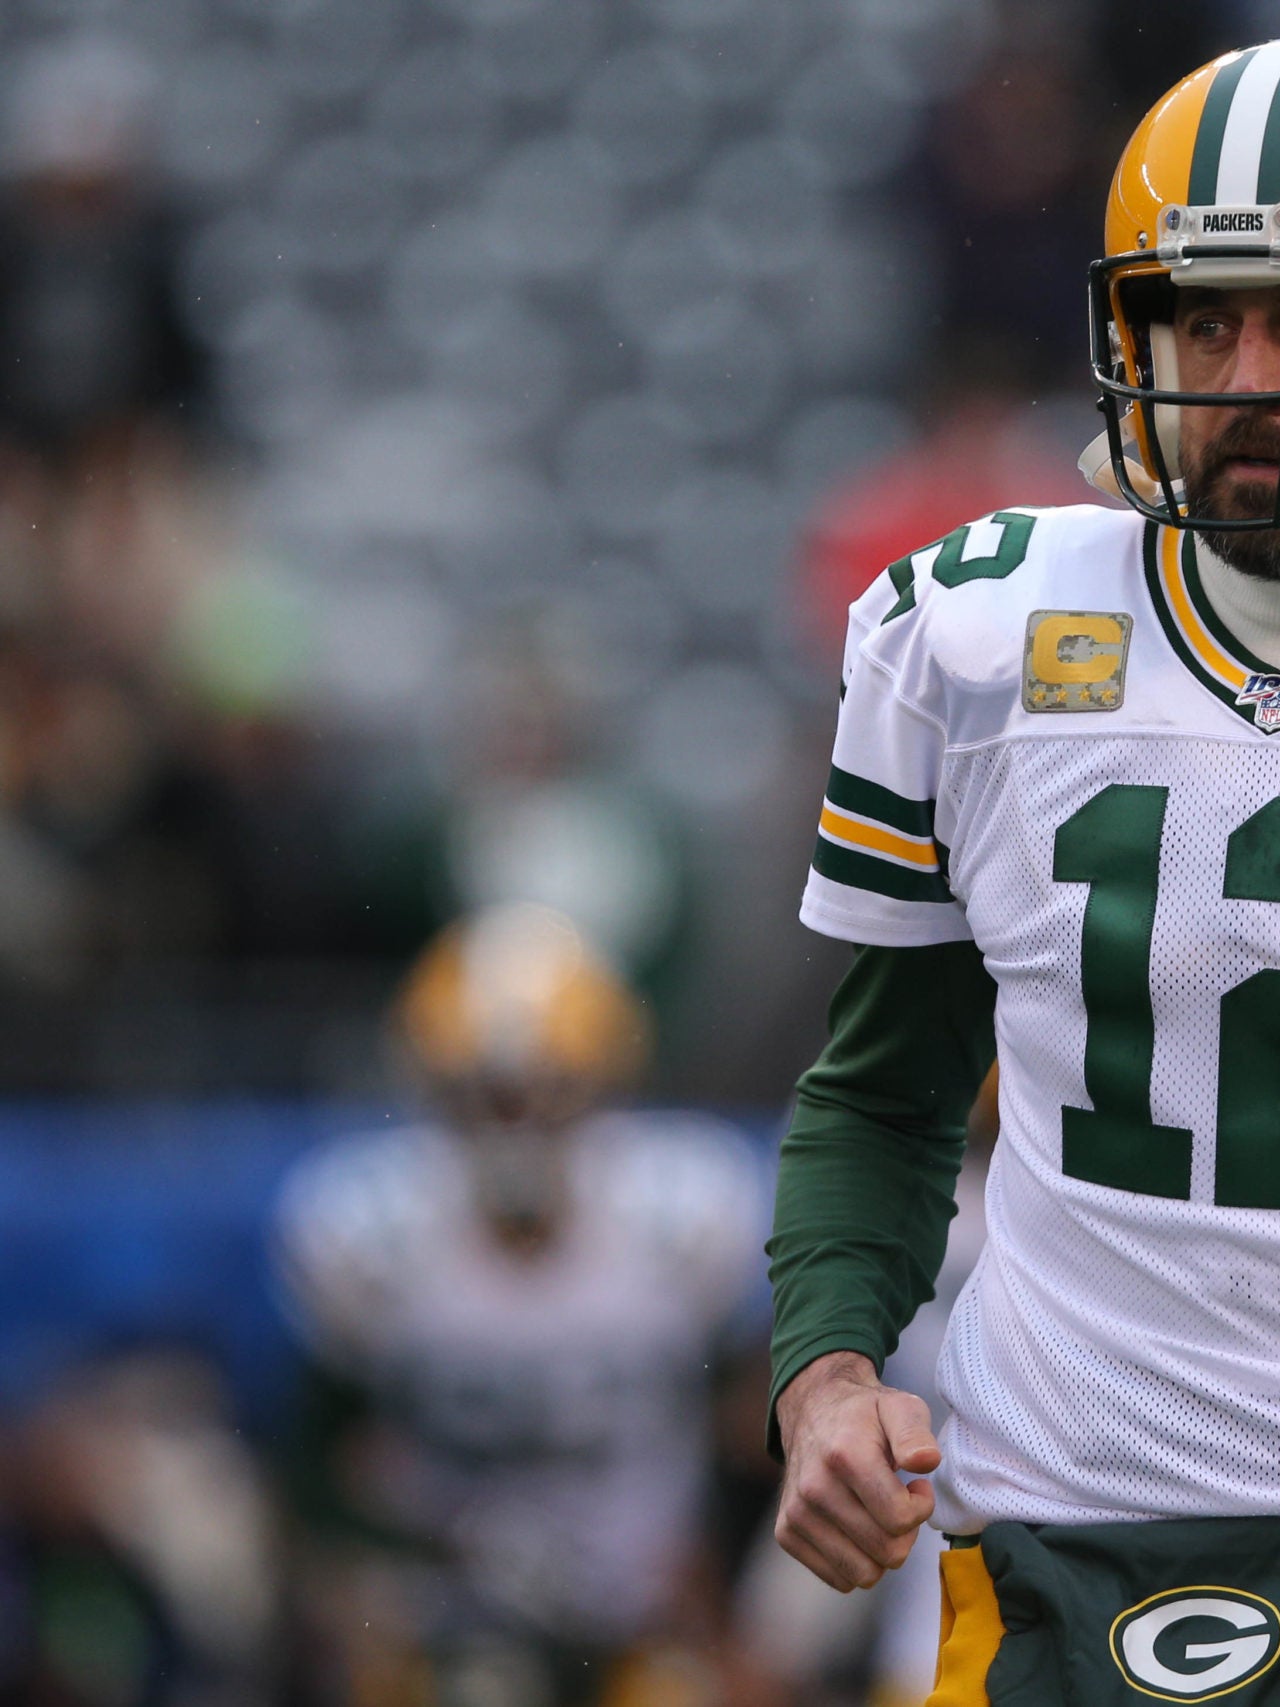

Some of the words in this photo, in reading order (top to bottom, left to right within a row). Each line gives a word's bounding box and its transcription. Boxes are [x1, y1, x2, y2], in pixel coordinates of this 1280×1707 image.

[1203, 213, 1264, 232] PACKERS
[1032, 616, 1123, 683] C
[1122, 1598, 1271, 1693] G
